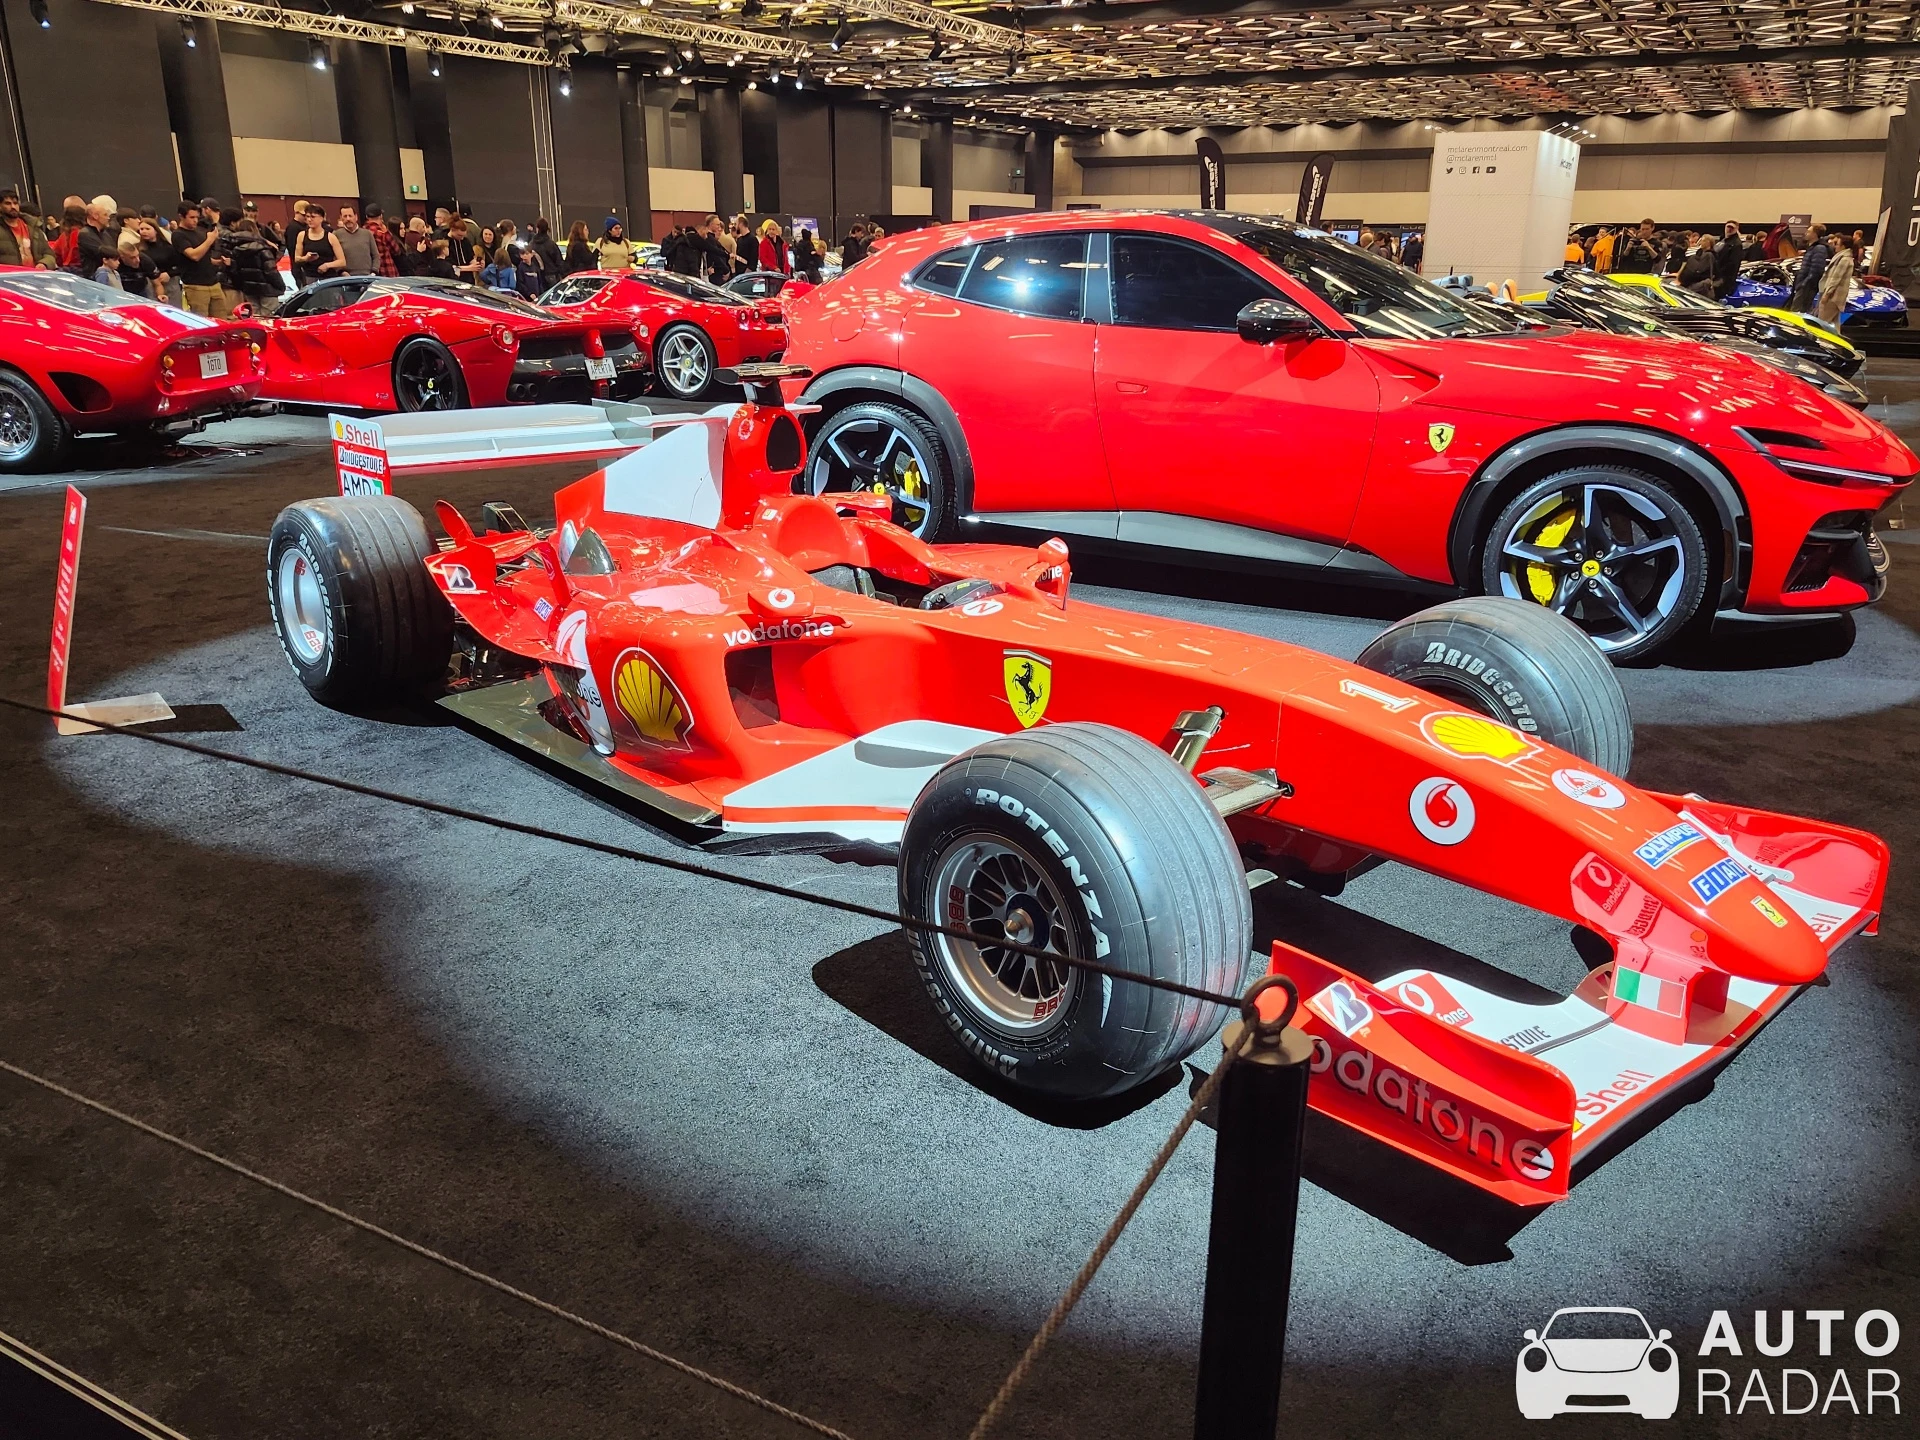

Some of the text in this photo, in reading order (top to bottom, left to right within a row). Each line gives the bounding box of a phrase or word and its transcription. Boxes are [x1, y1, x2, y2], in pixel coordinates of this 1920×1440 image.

[345, 424, 379, 448] Shell
[339, 447, 384, 472] BRIDGESTONE
[343, 473, 372, 496] AMD
[723, 619, 834, 647] vodafone
[1423, 642, 1542, 740] BRIDGESTO
[1638, 823, 1698, 860] OLYMPUS
[975, 788, 1111, 959] POTENZA
[1696, 859, 1746, 897] FIAT
[1310, 1034, 1555, 1181] odafone
[1575, 1069, 1655, 1116] Shell
